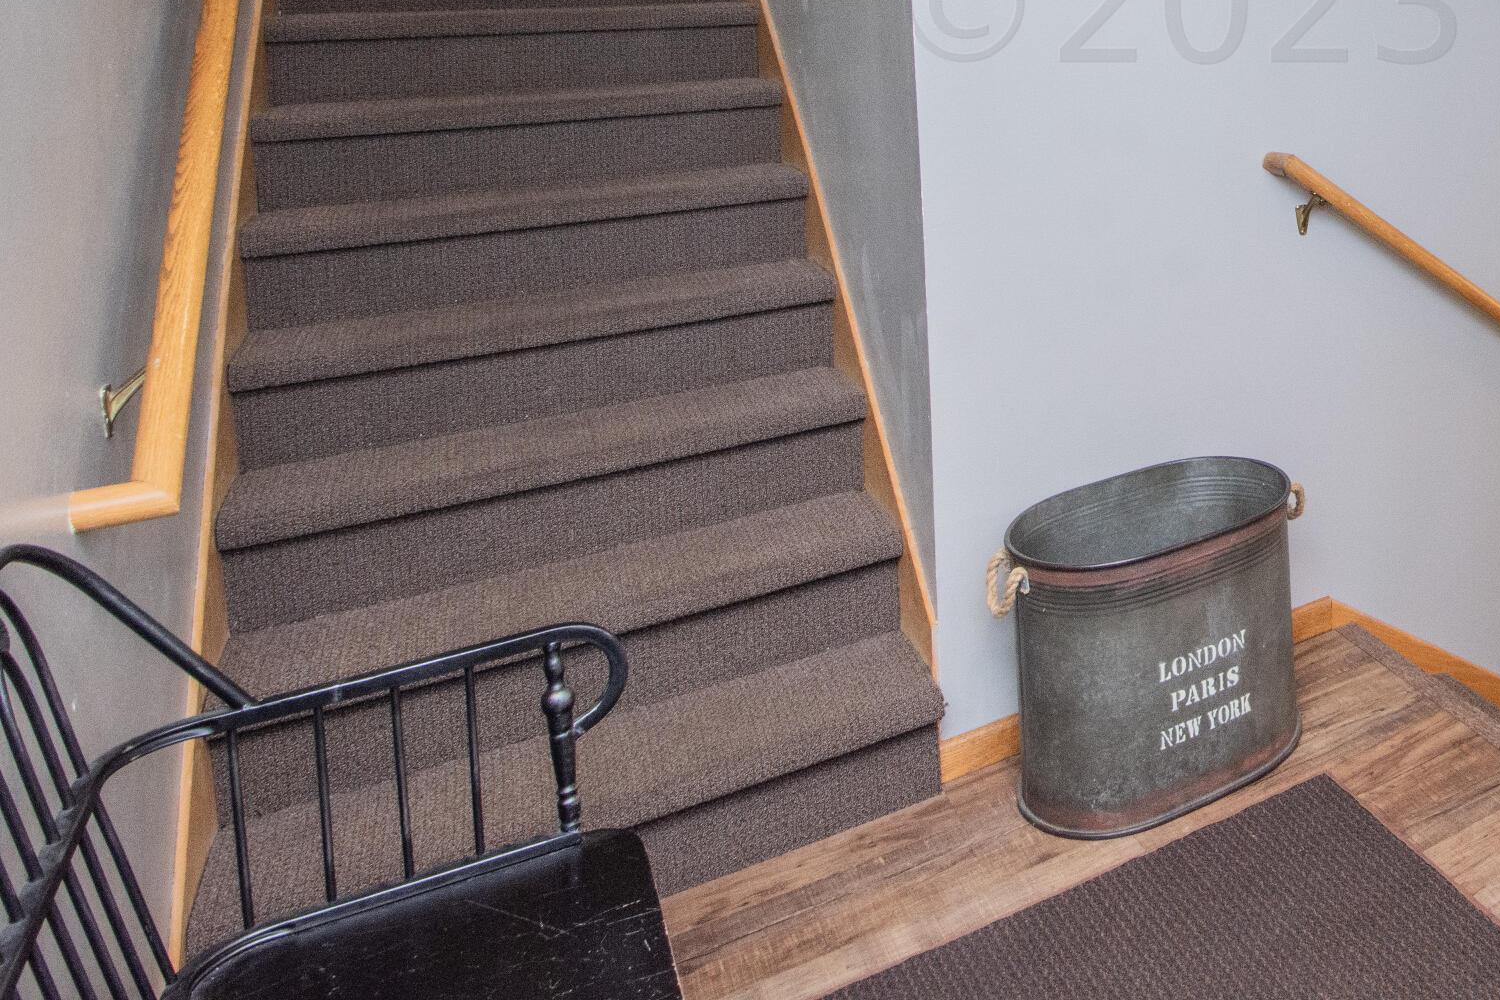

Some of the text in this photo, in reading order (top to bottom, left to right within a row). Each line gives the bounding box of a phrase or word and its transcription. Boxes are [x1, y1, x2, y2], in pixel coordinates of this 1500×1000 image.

[1159, 629, 1247, 683] LONDON
[1170, 665, 1240, 712] PARIS
[1160, 692, 1252, 751] NEW YORK
